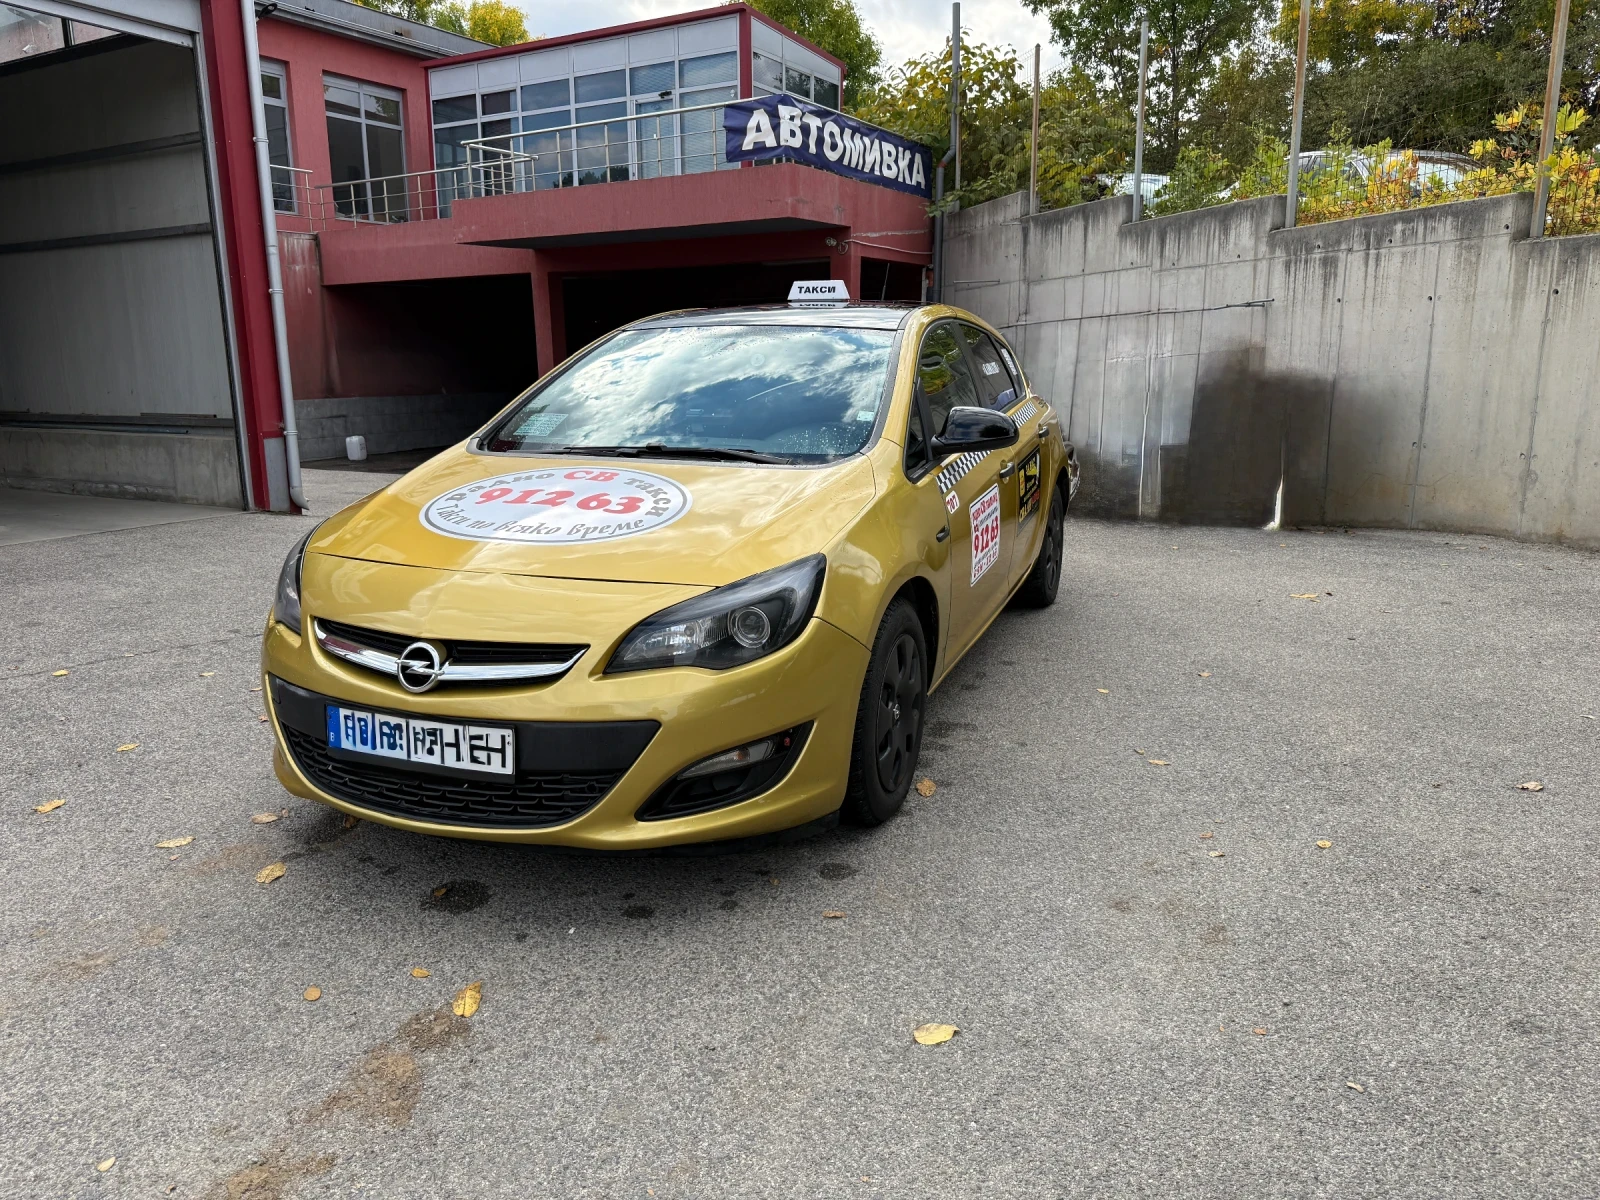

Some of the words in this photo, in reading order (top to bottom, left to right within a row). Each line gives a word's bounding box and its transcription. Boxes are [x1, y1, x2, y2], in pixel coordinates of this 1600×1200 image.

[741, 104, 926, 190] АВТОМИВКА
[797, 285, 836, 294] ТАКСИ
[563, 470, 620, 482] СВ
[566, 519, 645, 539] време
